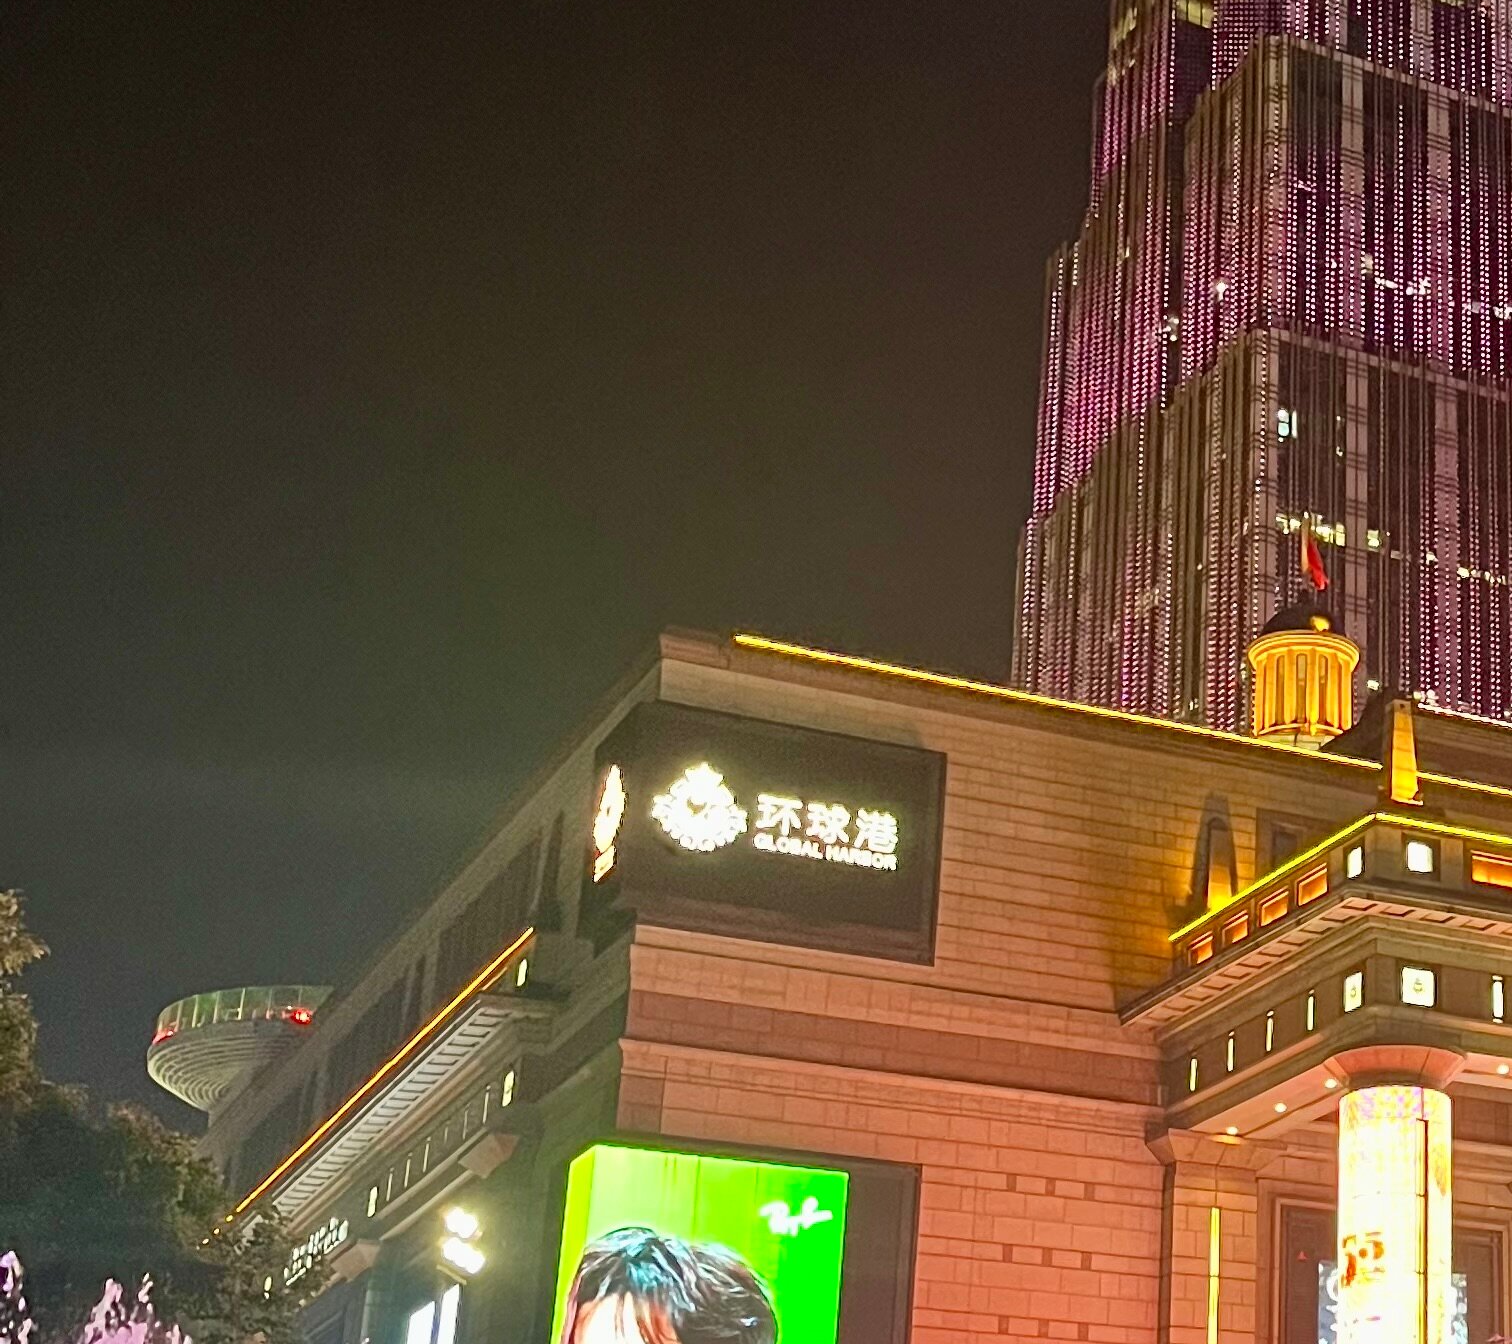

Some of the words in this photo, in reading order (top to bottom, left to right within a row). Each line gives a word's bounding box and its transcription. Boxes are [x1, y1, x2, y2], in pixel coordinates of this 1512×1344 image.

[756, 793, 899, 854] 环球港
[753, 832, 824, 860] GLOBAL
